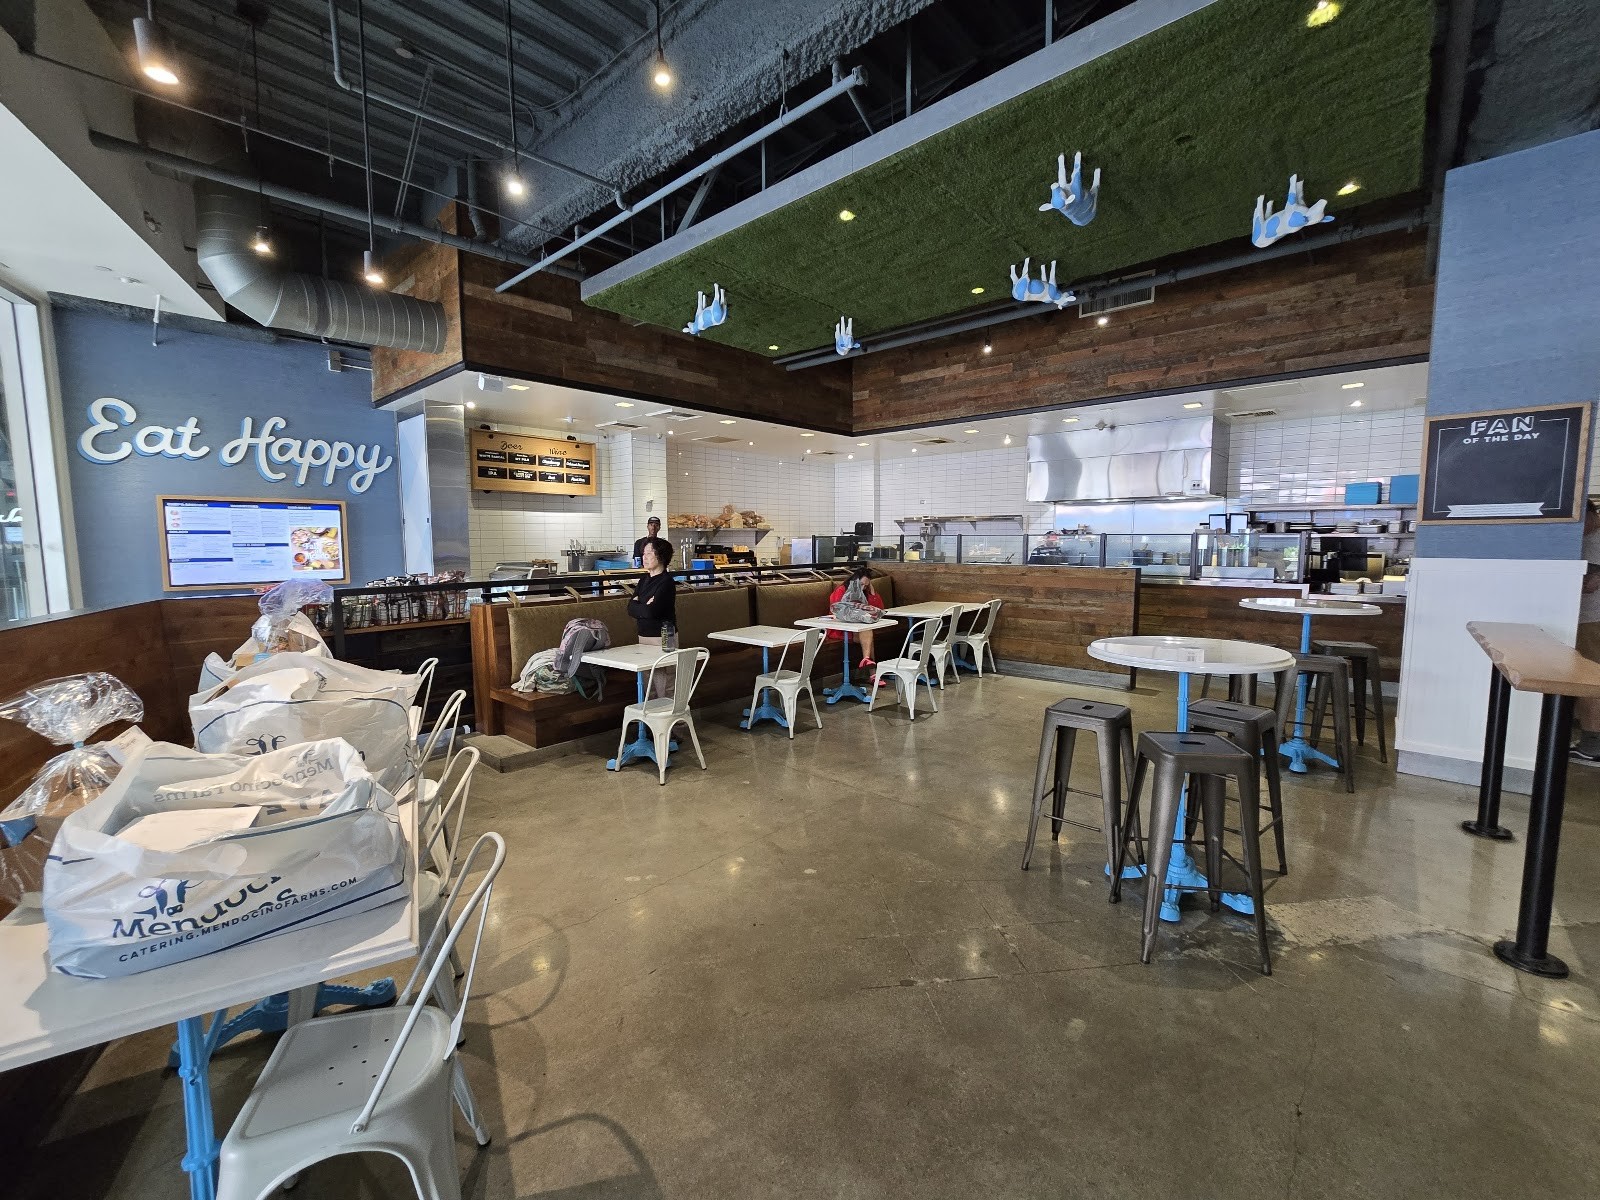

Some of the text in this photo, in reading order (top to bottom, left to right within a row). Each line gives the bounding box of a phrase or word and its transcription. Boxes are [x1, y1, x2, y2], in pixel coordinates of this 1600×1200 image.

[1470, 416, 1534, 436] FAN
[77, 397, 393, 494] Eat Happy
[500, 440, 523, 451] Beer
[1462, 432, 1540, 445] OF THE DAY
[549, 447, 567, 456] Wine
[118, 876, 359, 963] CATERING.MENDOCINOFARMS.COM
